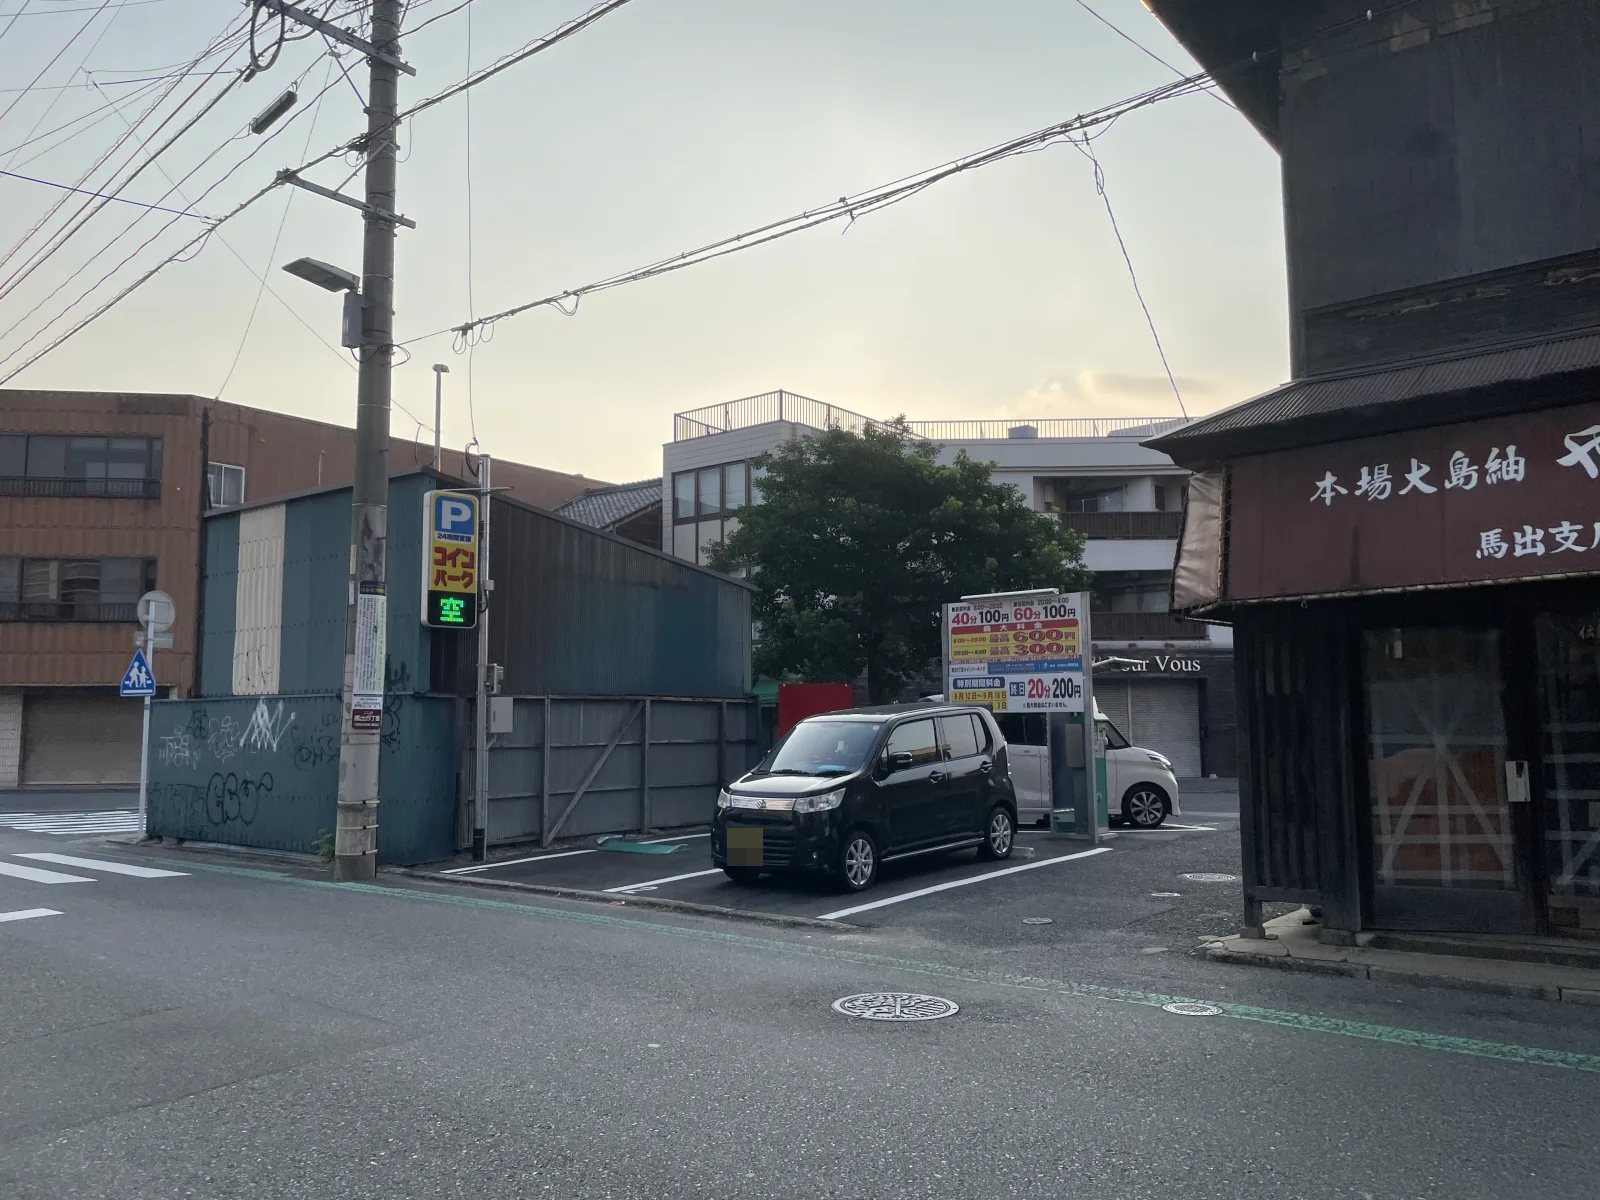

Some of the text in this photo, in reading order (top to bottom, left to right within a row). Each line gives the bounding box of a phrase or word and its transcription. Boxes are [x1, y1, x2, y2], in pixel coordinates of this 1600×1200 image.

[1309, 444, 1526, 506] 本場大島紬
[441, 500, 472, 530] P
[434, 546, 474, 569] コイン
[434, 569, 473, 588] パーク
[440, 597, 464, 622] 空
[952, 612, 977, 625] 40分
[979, 609, 1009, 623] 100円
[1014, 604, 1076, 621] 60分 100円
[1013, 629, 1075, 643] 600円
[1013, 642, 1076, 656] 300円
[1154, 655, 1201, 672] Vous
[957, 678, 1001, 688] 特別期間料金
[1010, 684, 1025, 696] 終日
[1028, 678, 1081, 699] 20分 200円
